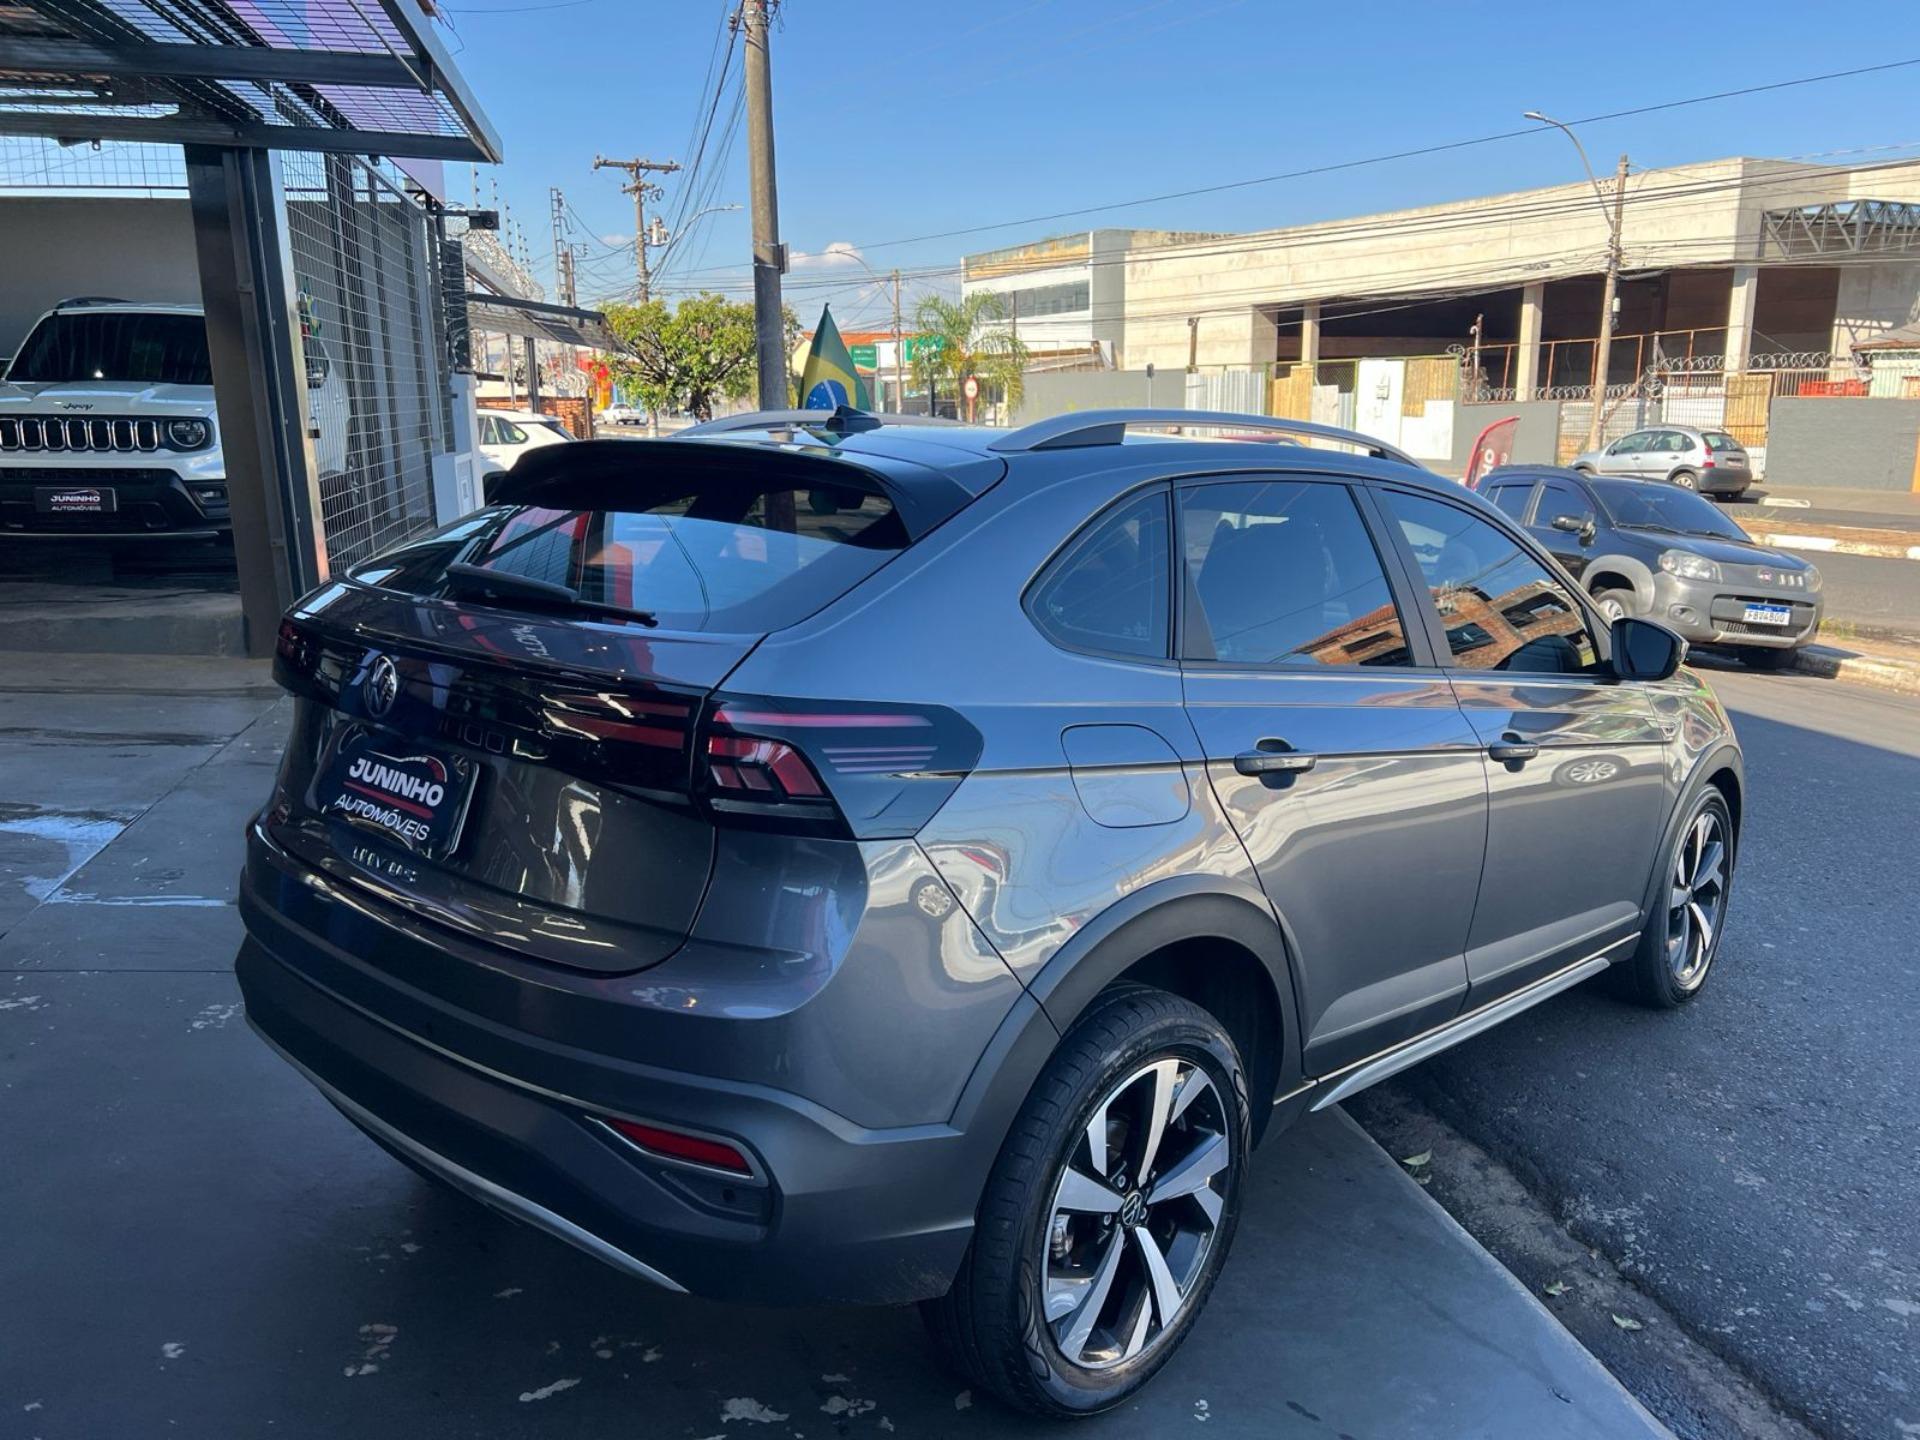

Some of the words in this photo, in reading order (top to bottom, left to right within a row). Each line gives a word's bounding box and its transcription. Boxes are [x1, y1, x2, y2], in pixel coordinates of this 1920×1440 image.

[50, 494, 102, 503] JUNINHO
[349, 758, 444, 807] JUNINHO
[333, 793, 431, 842] AUTOMÓVEIS
